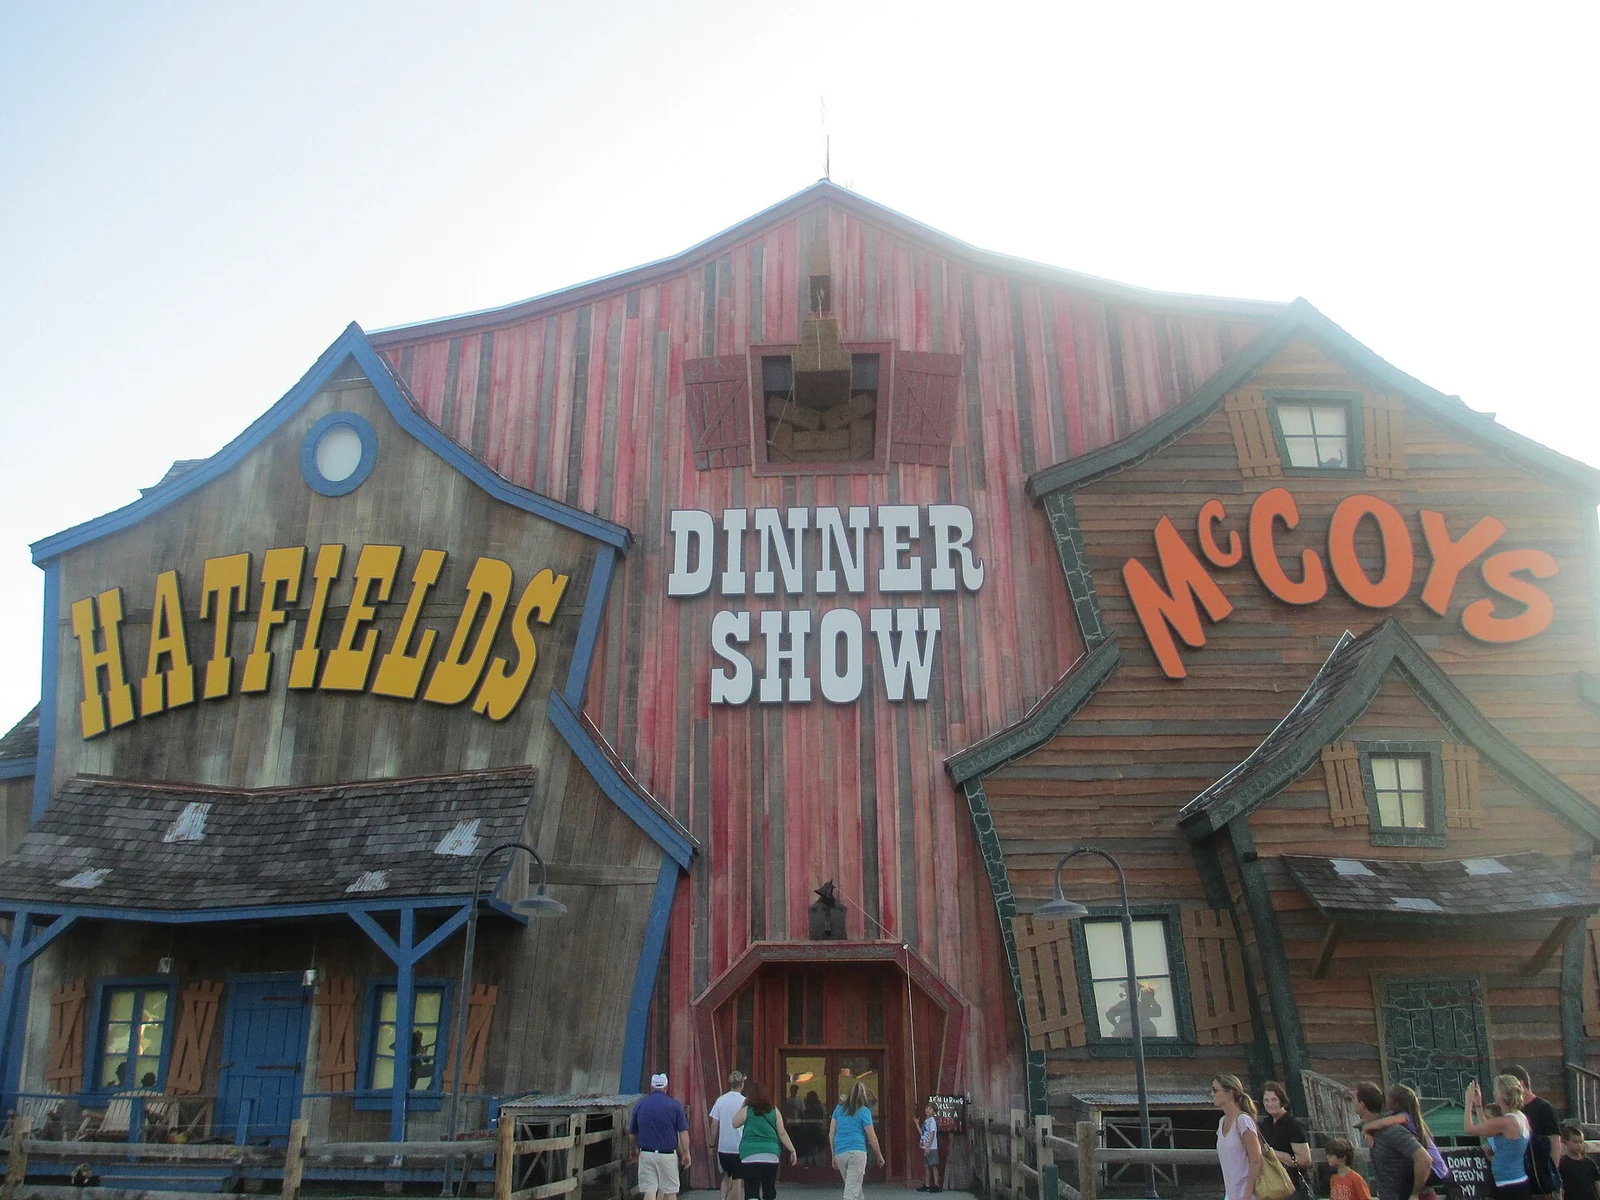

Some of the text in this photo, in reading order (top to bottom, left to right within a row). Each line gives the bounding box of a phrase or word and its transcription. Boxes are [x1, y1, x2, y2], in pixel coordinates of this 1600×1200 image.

[668, 504, 985, 598] DINNER
[71, 543, 569, 740] HATFIELDS
[710, 607, 942, 705] SHOW
[1452, 1168, 1485, 1182] FEED'N
[1460, 1183, 1475, 1197] MY
[1473, 1156, 1487, 1170] BE
